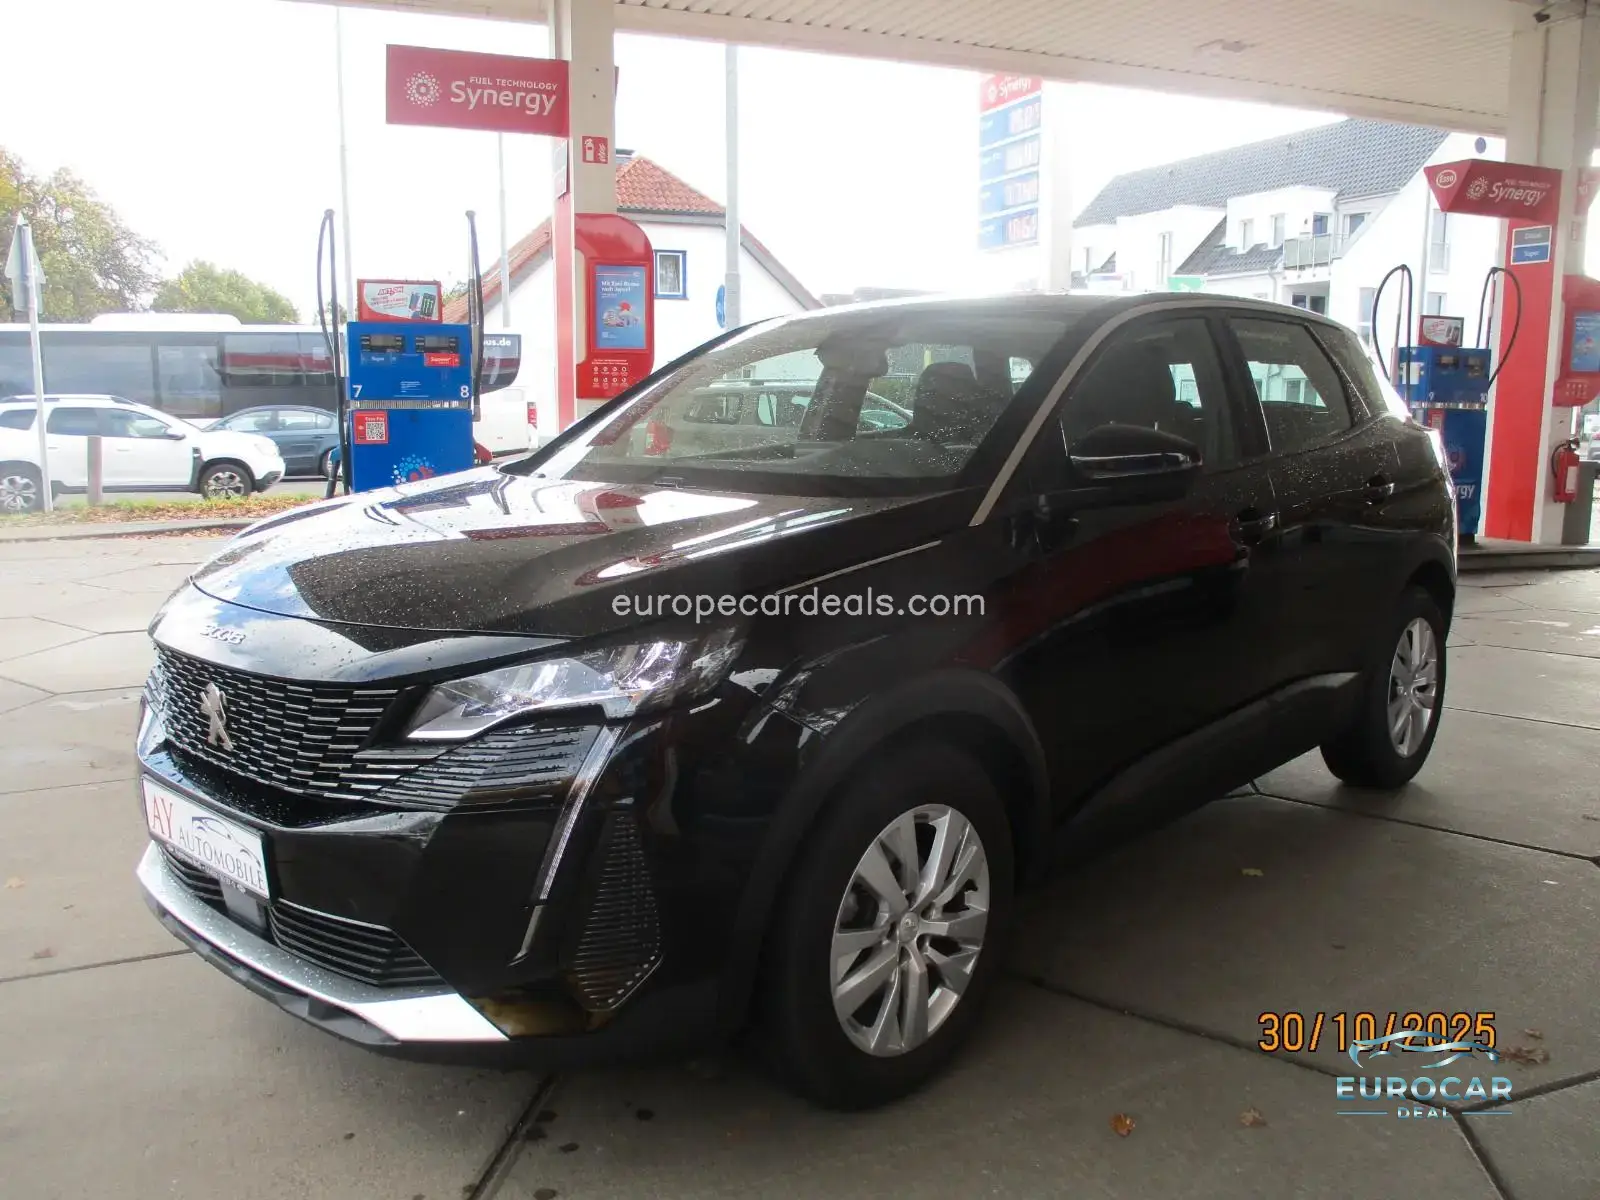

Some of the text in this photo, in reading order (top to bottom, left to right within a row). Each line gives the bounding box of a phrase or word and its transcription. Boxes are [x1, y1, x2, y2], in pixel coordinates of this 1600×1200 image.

[469, 76, 559, 91] FUEL TECHNOLOGY
[450, 81, 558, 116] Synergy
[1488, 181, 1546, 206] Synergy
[483, 338, 512, 347] us.de
[352, 384, 363, 398] 7
[460, 385, 470, 398] 8
[1428, 392, 1436, 401] 9
[152, 795, 174, 840] AY
[178, 826, 266, 891] AUTOMOBILE
